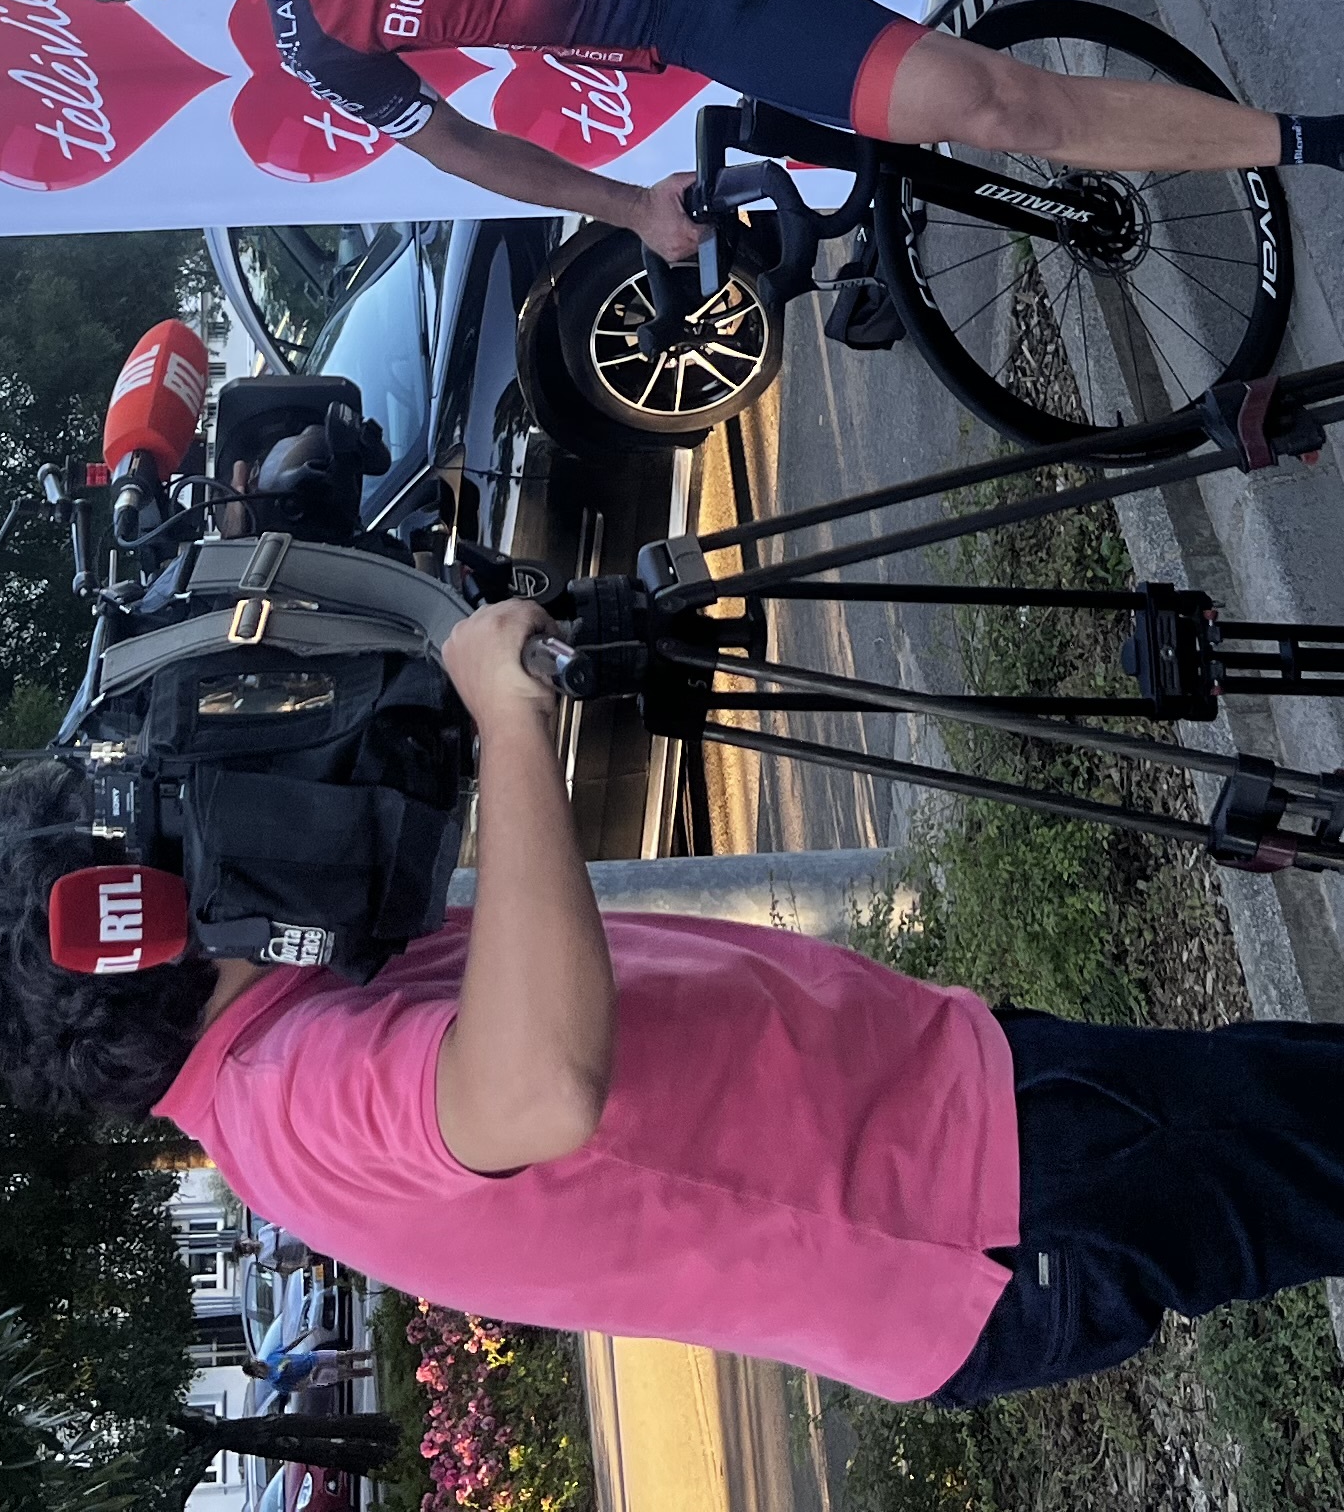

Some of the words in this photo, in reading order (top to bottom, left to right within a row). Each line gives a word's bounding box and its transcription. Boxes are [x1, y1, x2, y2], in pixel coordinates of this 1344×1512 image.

[974, 183, 1096, 222] SPECIALIZED
[1247, 166, 1277, 299] oval
[109, 344, 160, 409] RTL
[162, 352, 205, 416] RTL
[112, 787, 120, 816] SONY
[99, 873, 143, 942] RTL
[93, 948, 141, 974] TL
